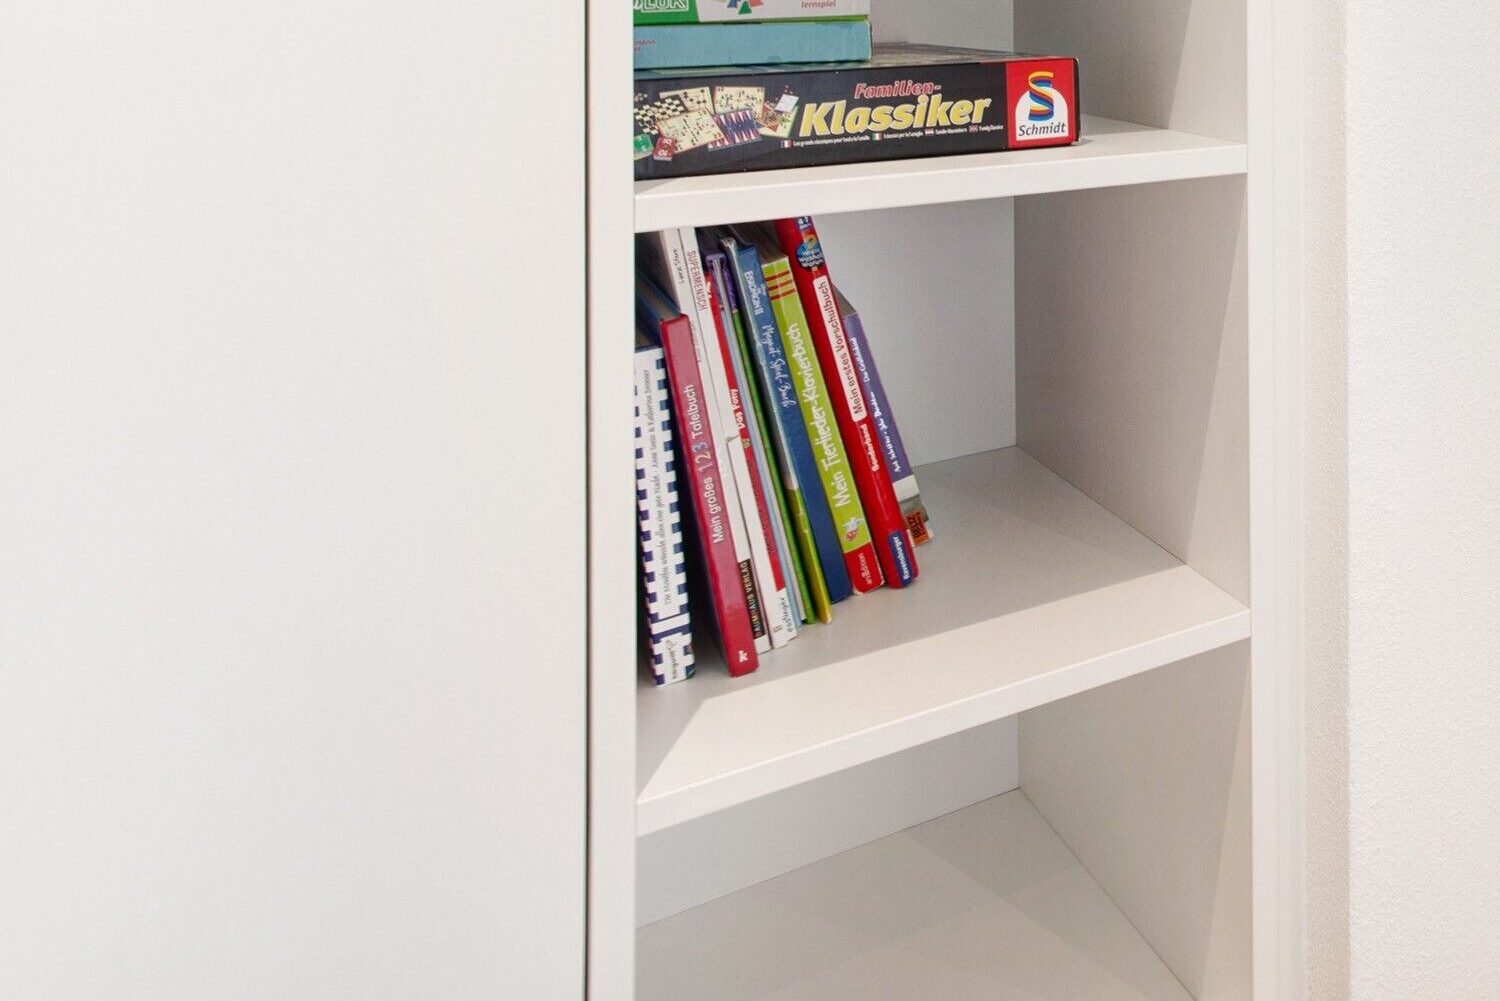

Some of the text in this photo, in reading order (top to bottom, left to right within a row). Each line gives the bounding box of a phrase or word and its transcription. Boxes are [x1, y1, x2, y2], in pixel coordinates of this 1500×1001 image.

[801, 0, 836, 9] lernspiel
[854, 80, 942, 99] Familien-
[798, 94, 992, 137] Klassiker
[1018, 121, 1067, 137] Schmidt
[686, 250, 708, 311] SUPERMENSCH
[818, 281, 863, 415] Mein erstes Vorschulbuch
[684, 384, 702, 440] Tafelbuch
[730, 388, 741, 411] Pony
[735, 412, 746, 429] Das
[786, 323, 851, 507] Mein Tierlieder-Klavierbuch
[860, 423, 880, 471] Sonderband
[704, 477, 721, 514] großes
[711, 515, 725, 543] Mein
[893, 536, 910, 580] Ravensburger
[740, 560, 762, 638] BAUMHAUS VERLAG
